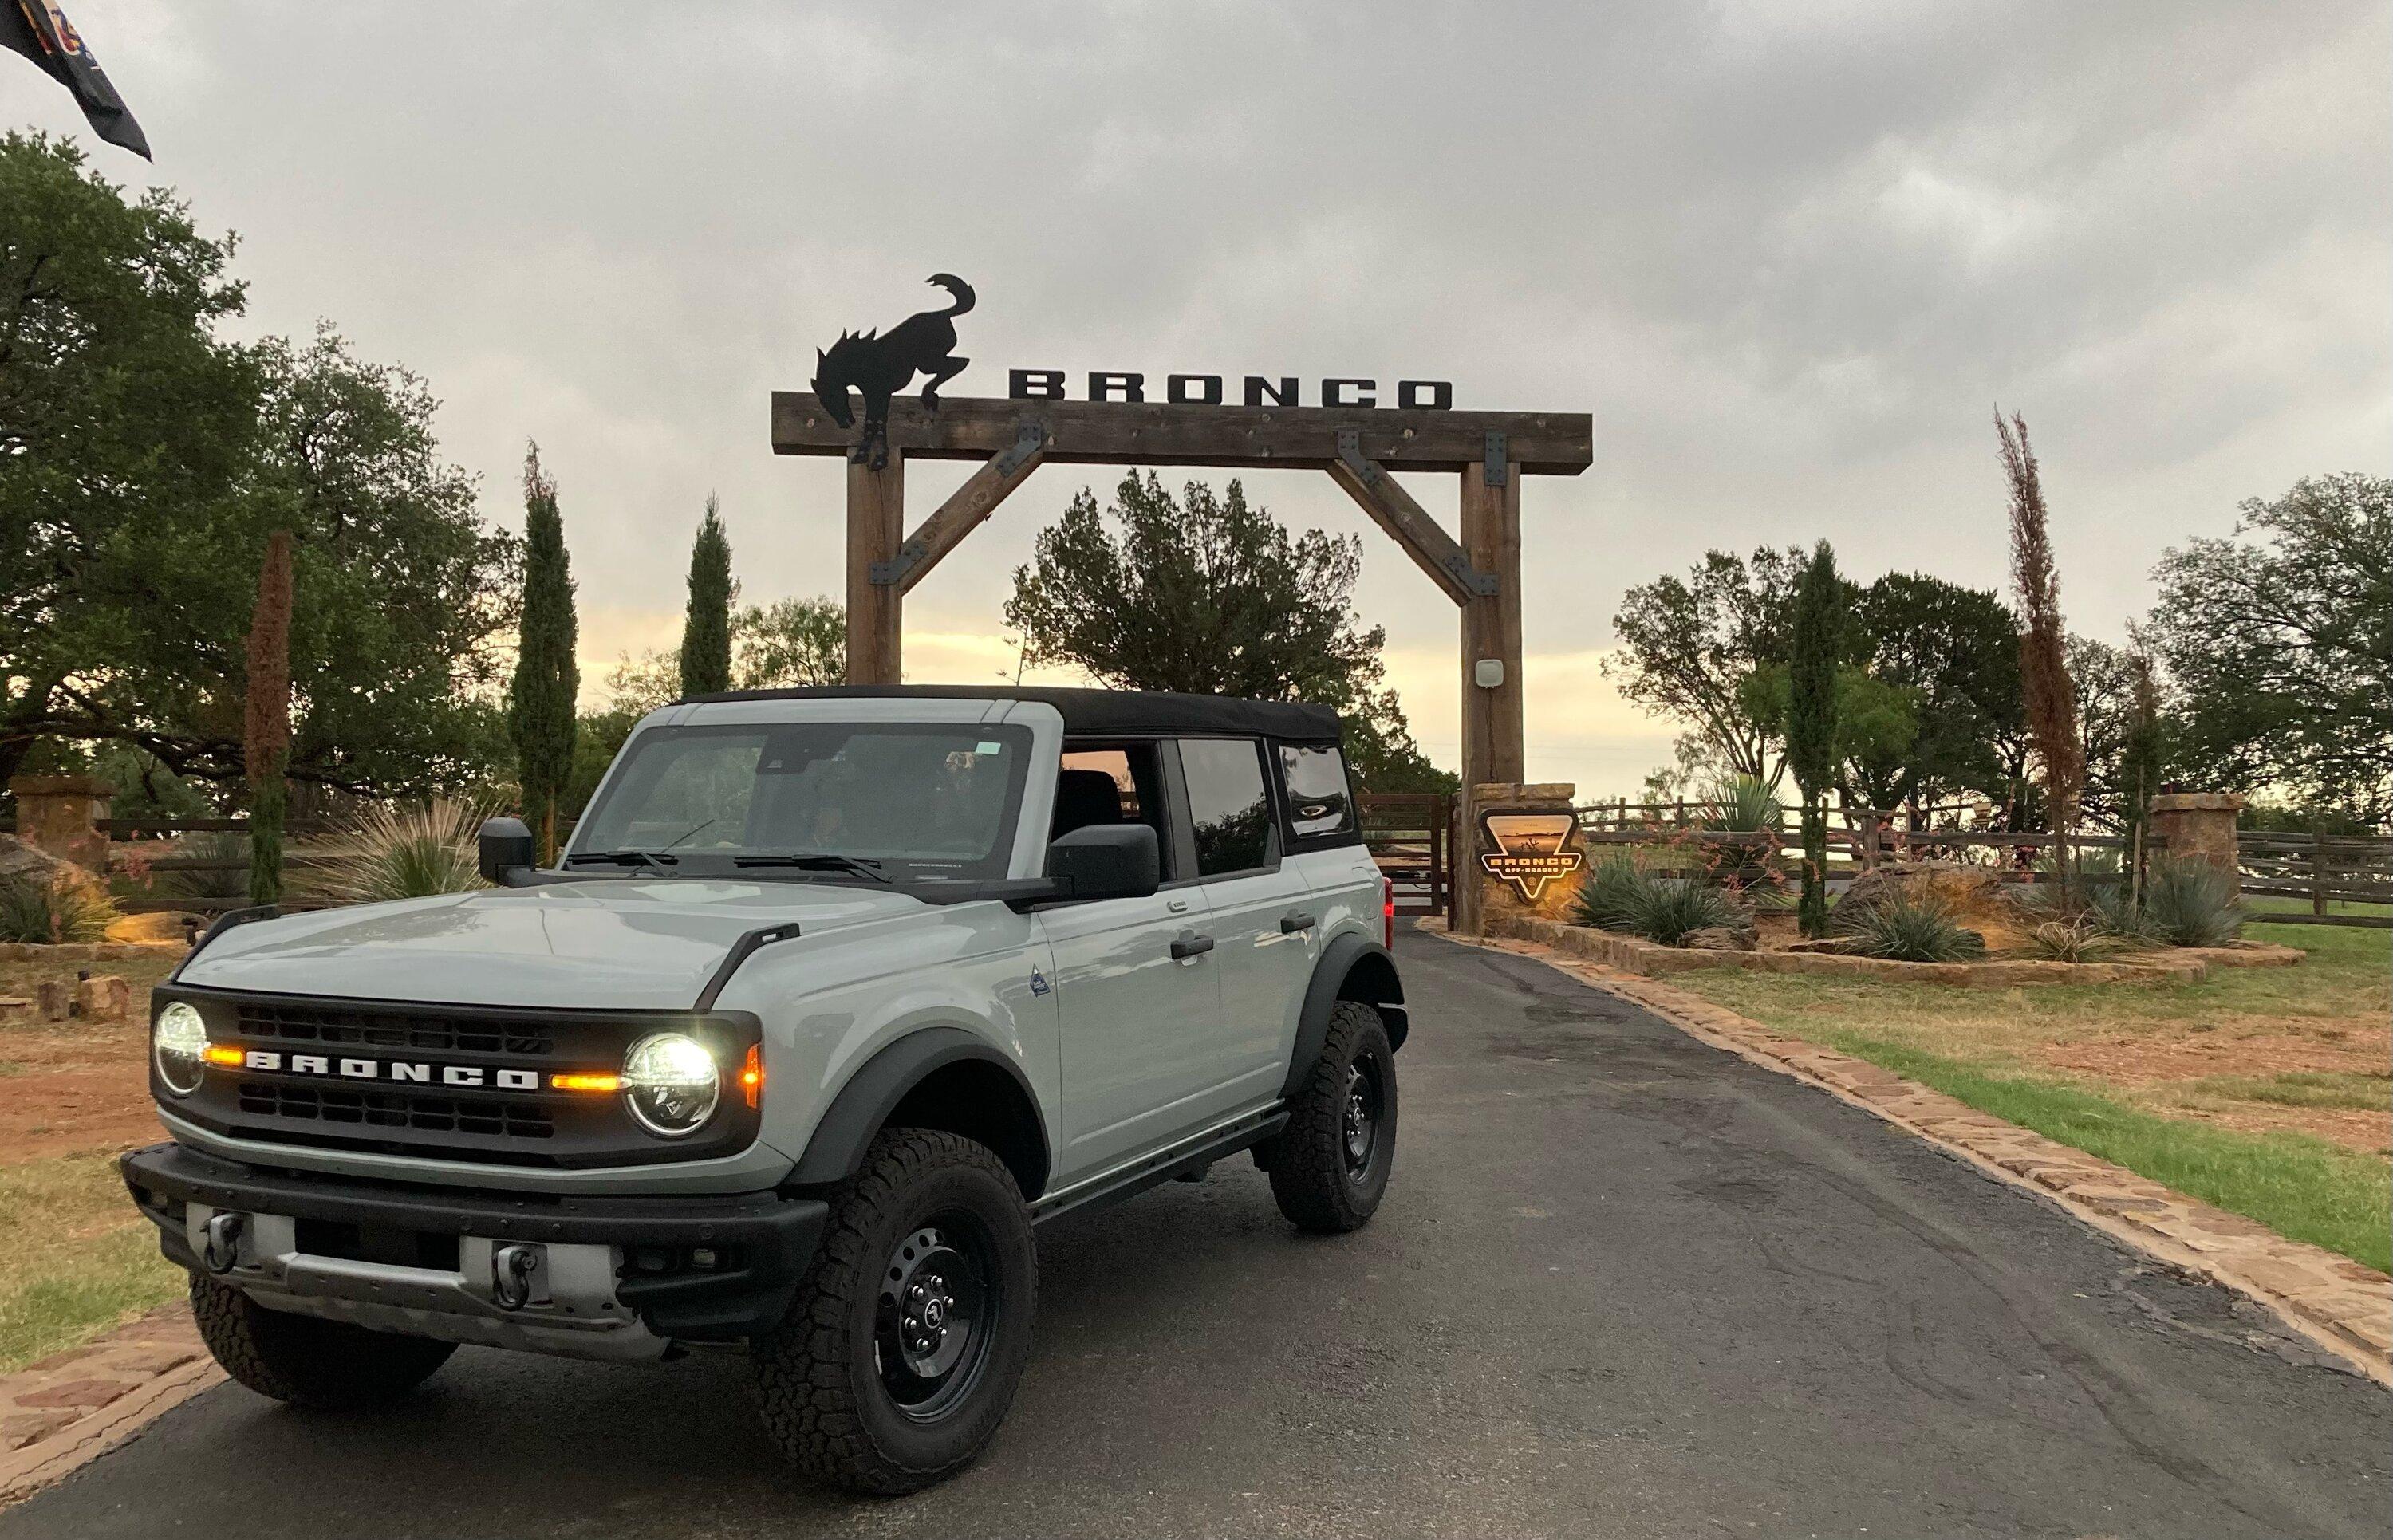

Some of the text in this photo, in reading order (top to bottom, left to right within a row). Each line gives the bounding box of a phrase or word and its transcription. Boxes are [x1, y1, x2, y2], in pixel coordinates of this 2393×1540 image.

[1009, 368, 1453, 411] BRONCO
[1490, 857, 1573, 866] BRONCO
[246, 1050, 539, 1090] BRONCO
